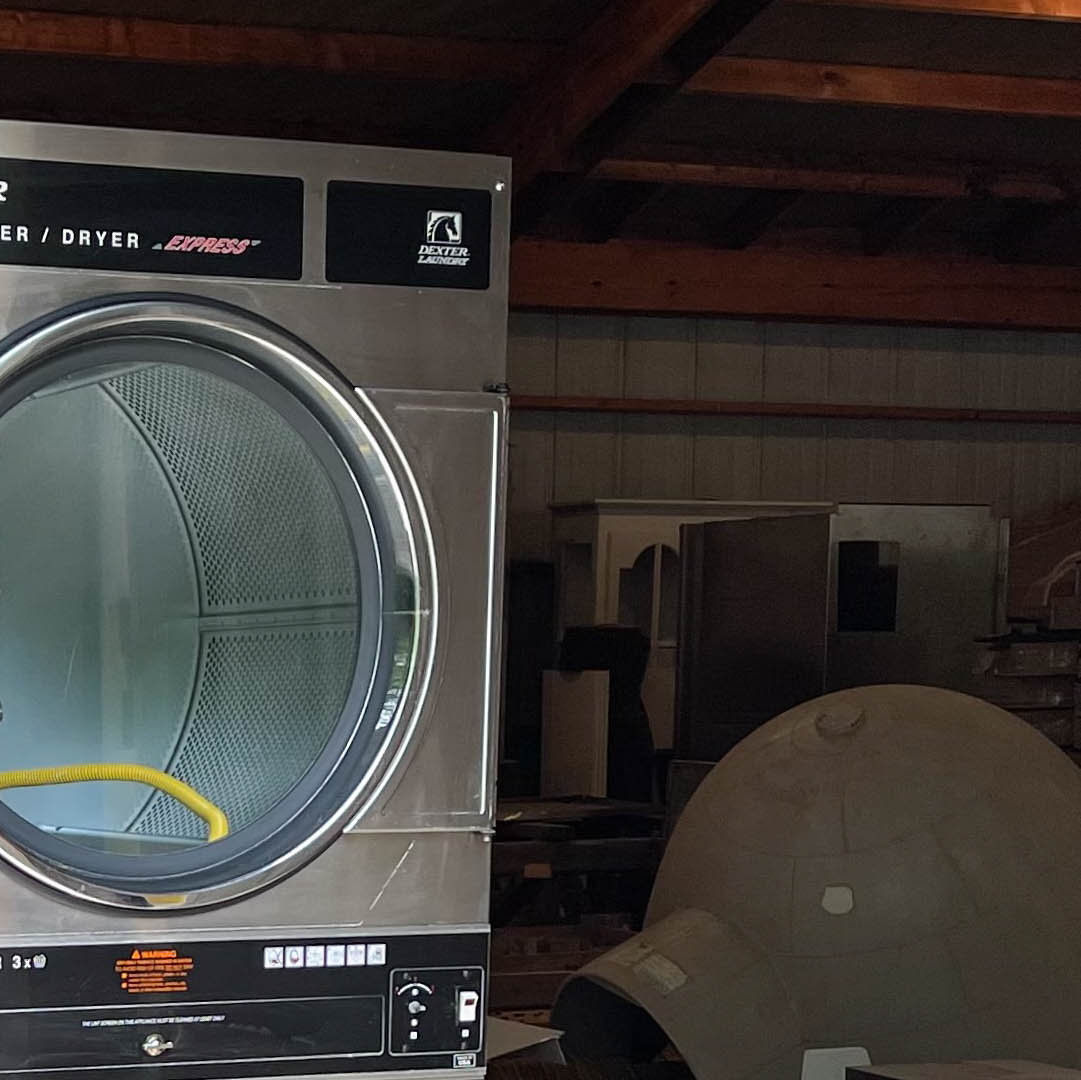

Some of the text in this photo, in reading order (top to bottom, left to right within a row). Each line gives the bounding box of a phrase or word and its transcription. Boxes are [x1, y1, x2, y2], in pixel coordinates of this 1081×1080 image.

[41, 227, 49, 243] /
[62, 228, 139, 249] DRYER
[163, 235, 250, 255] EXPRESS
[418, 244, 469, 256] DEXTER
[417, 255, 470, 266] LAUNDRY
